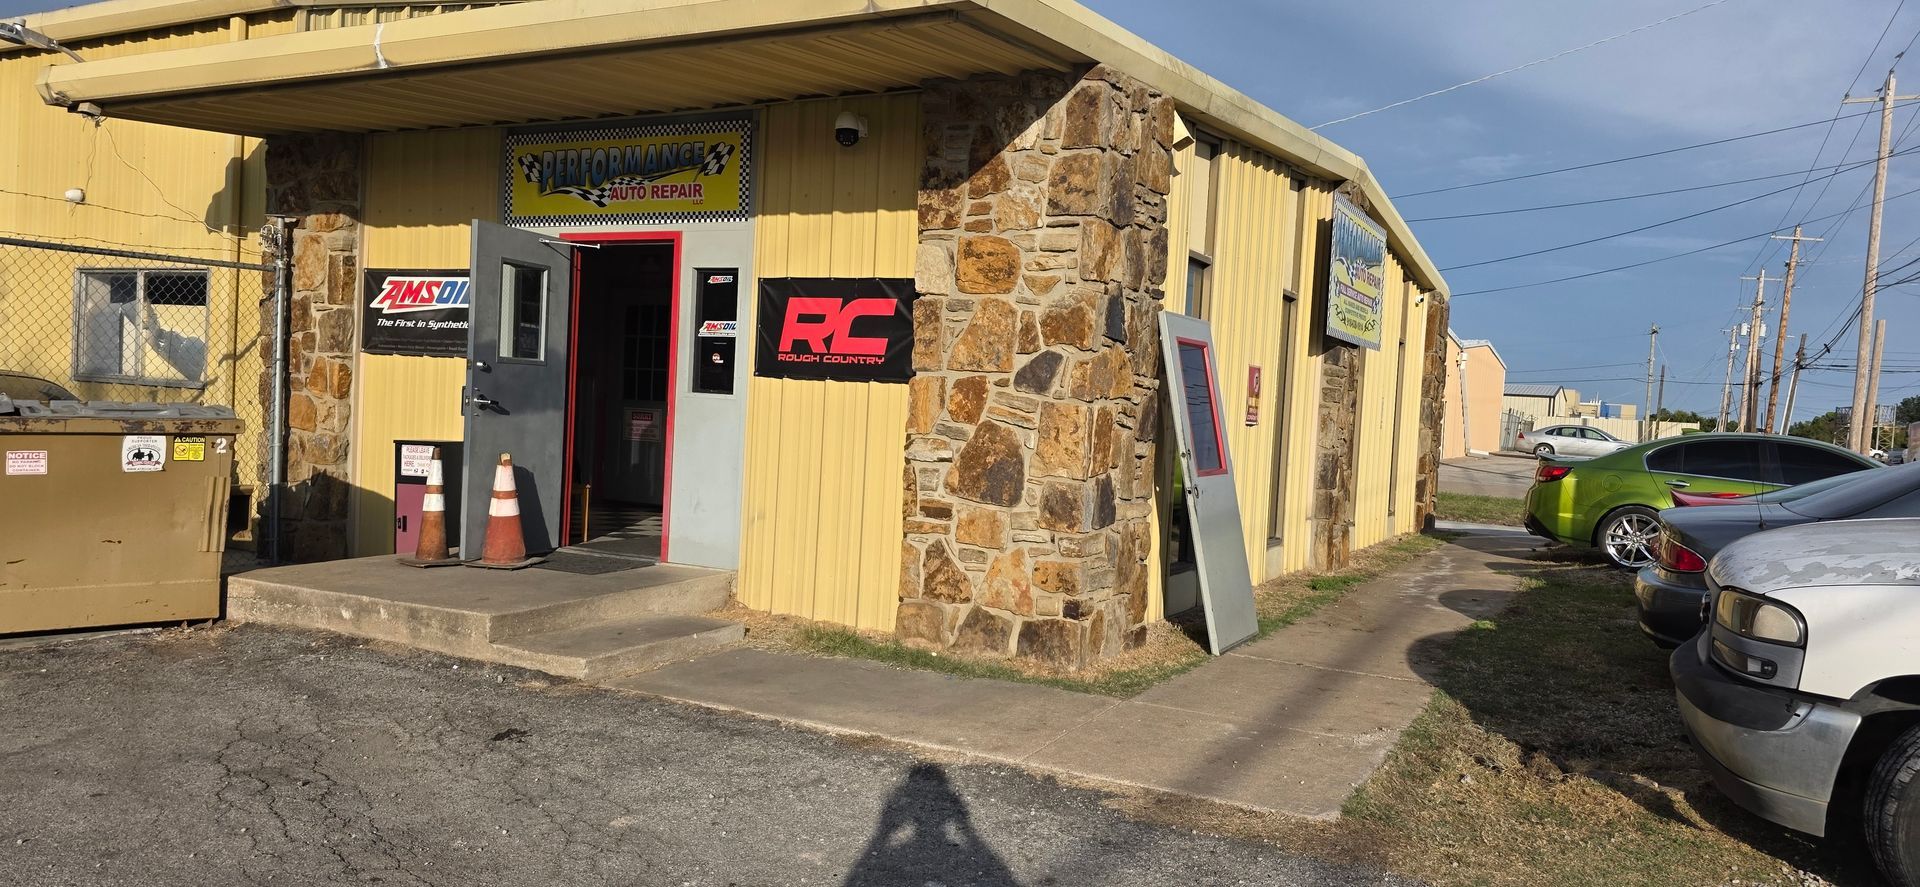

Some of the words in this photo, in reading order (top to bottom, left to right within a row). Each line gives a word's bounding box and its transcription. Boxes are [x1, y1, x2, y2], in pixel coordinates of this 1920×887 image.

[540, 141, 704, 192] PERFORMANCE
[610, 184, 646, 200] AUTO
[651, 183, 703, 199] REPAIR
[376, 280, 469, 310] AMSOIL
[377, 318, 394, 327] The
[395, 319, 416, 328] First
[703, 322, 737, 332] AMSOIL
[778, 296, 897, 356] RC
[778, 353, 819, 363] ROUGH
[823, 355, 885, 365] COUNTRY
[216, 437, 227, 454] 2
